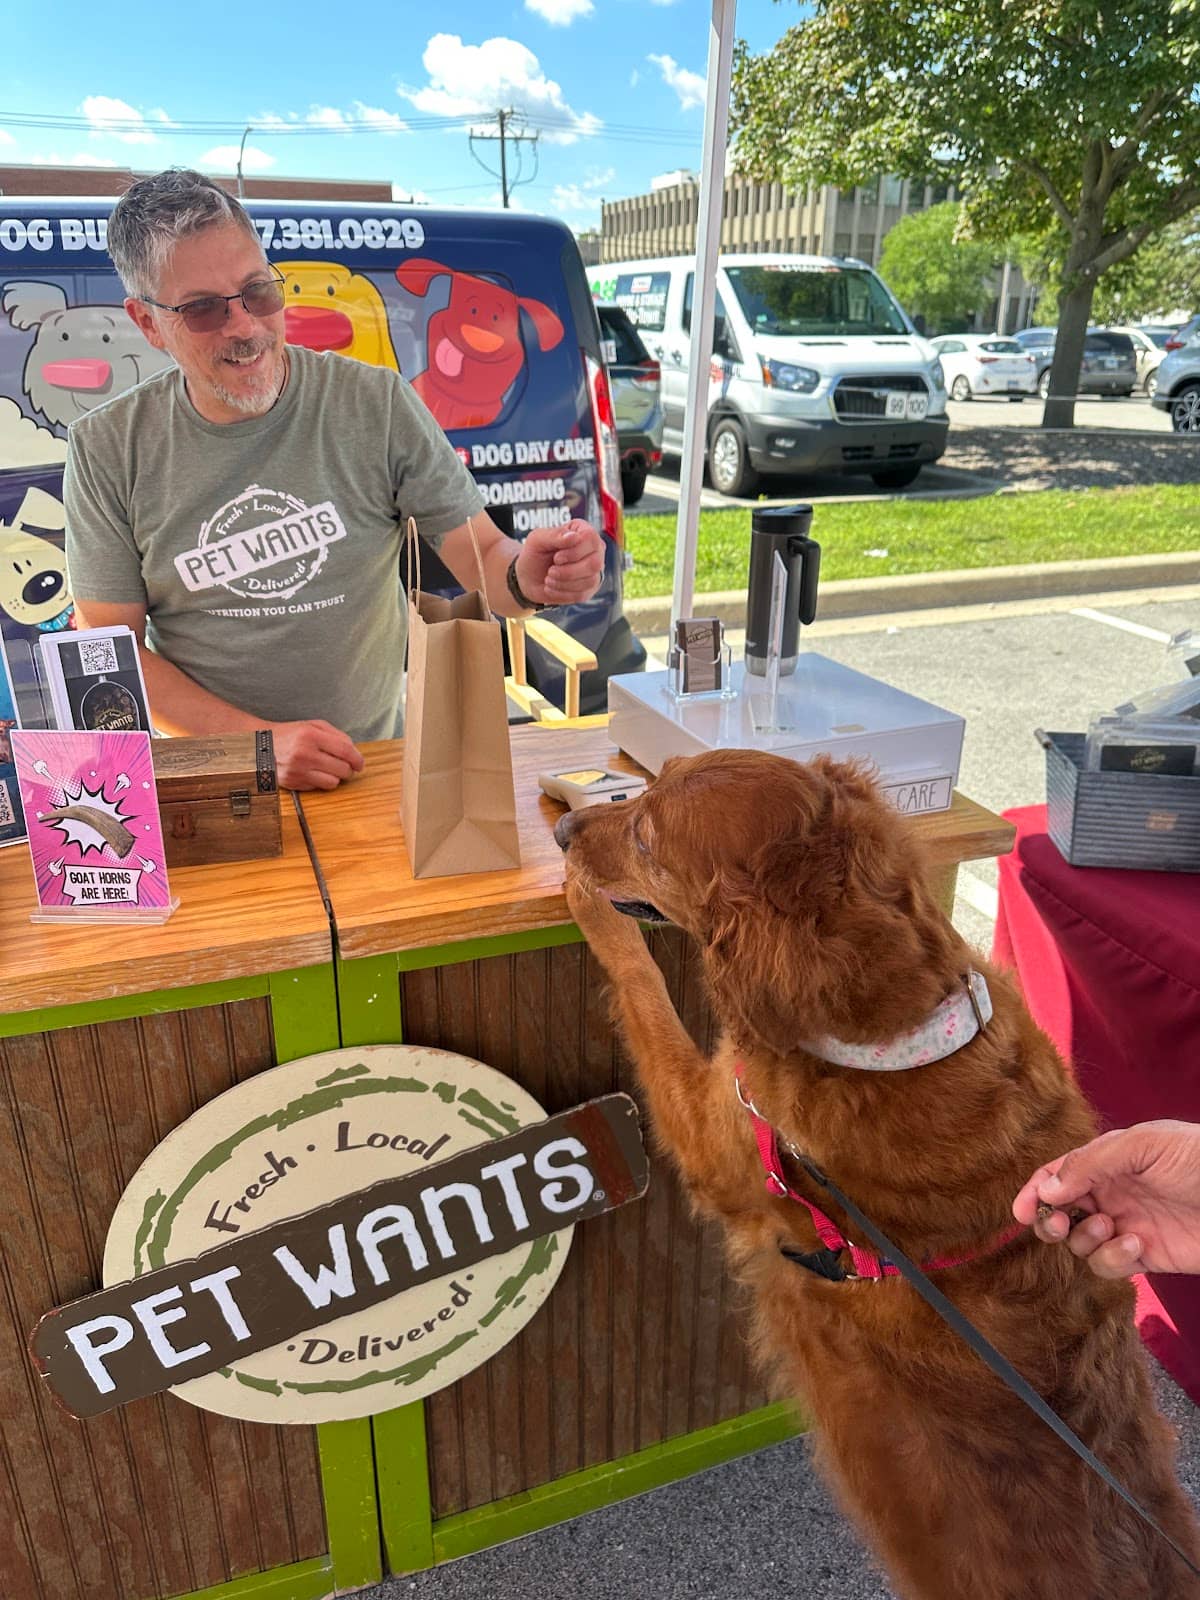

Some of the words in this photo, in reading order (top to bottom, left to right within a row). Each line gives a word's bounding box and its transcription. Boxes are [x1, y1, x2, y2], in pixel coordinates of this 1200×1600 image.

[251, 218, 425, 250] 7.381.0829
[472, 443, 513, 467] DOG
[515, 440, 550, 464] DAY
[553, 437, 594, 461] CARE
[254, 499, 290, 517] Local
[513, 506, 571, 531] OMING
[184, 544, 238, 584] PET
[241, 511, 337, 563] WANTS
[247, 561, 306, 591] Delivered
[203, 608, 260, 618] UTRITION
[262, 606, 287, 617] YOU
[288, 603, 312, 614] CAN
[314, 594, 345, 610] TRUST
[896, 782, 937, 812] CARE
[69, 872, 95, 884] GOAT
[99, 872, 131, 884] HORNS
[82, 888, 99, 899] ARE
[103, 888, 129, 899] HERE!
[204, 1151, 298, 1233] Fresh
[335, 1121, 451, 1161] Local
[65, 1265, 252, 1395] PET
[299, 1280, 476, 1366] Delivered
